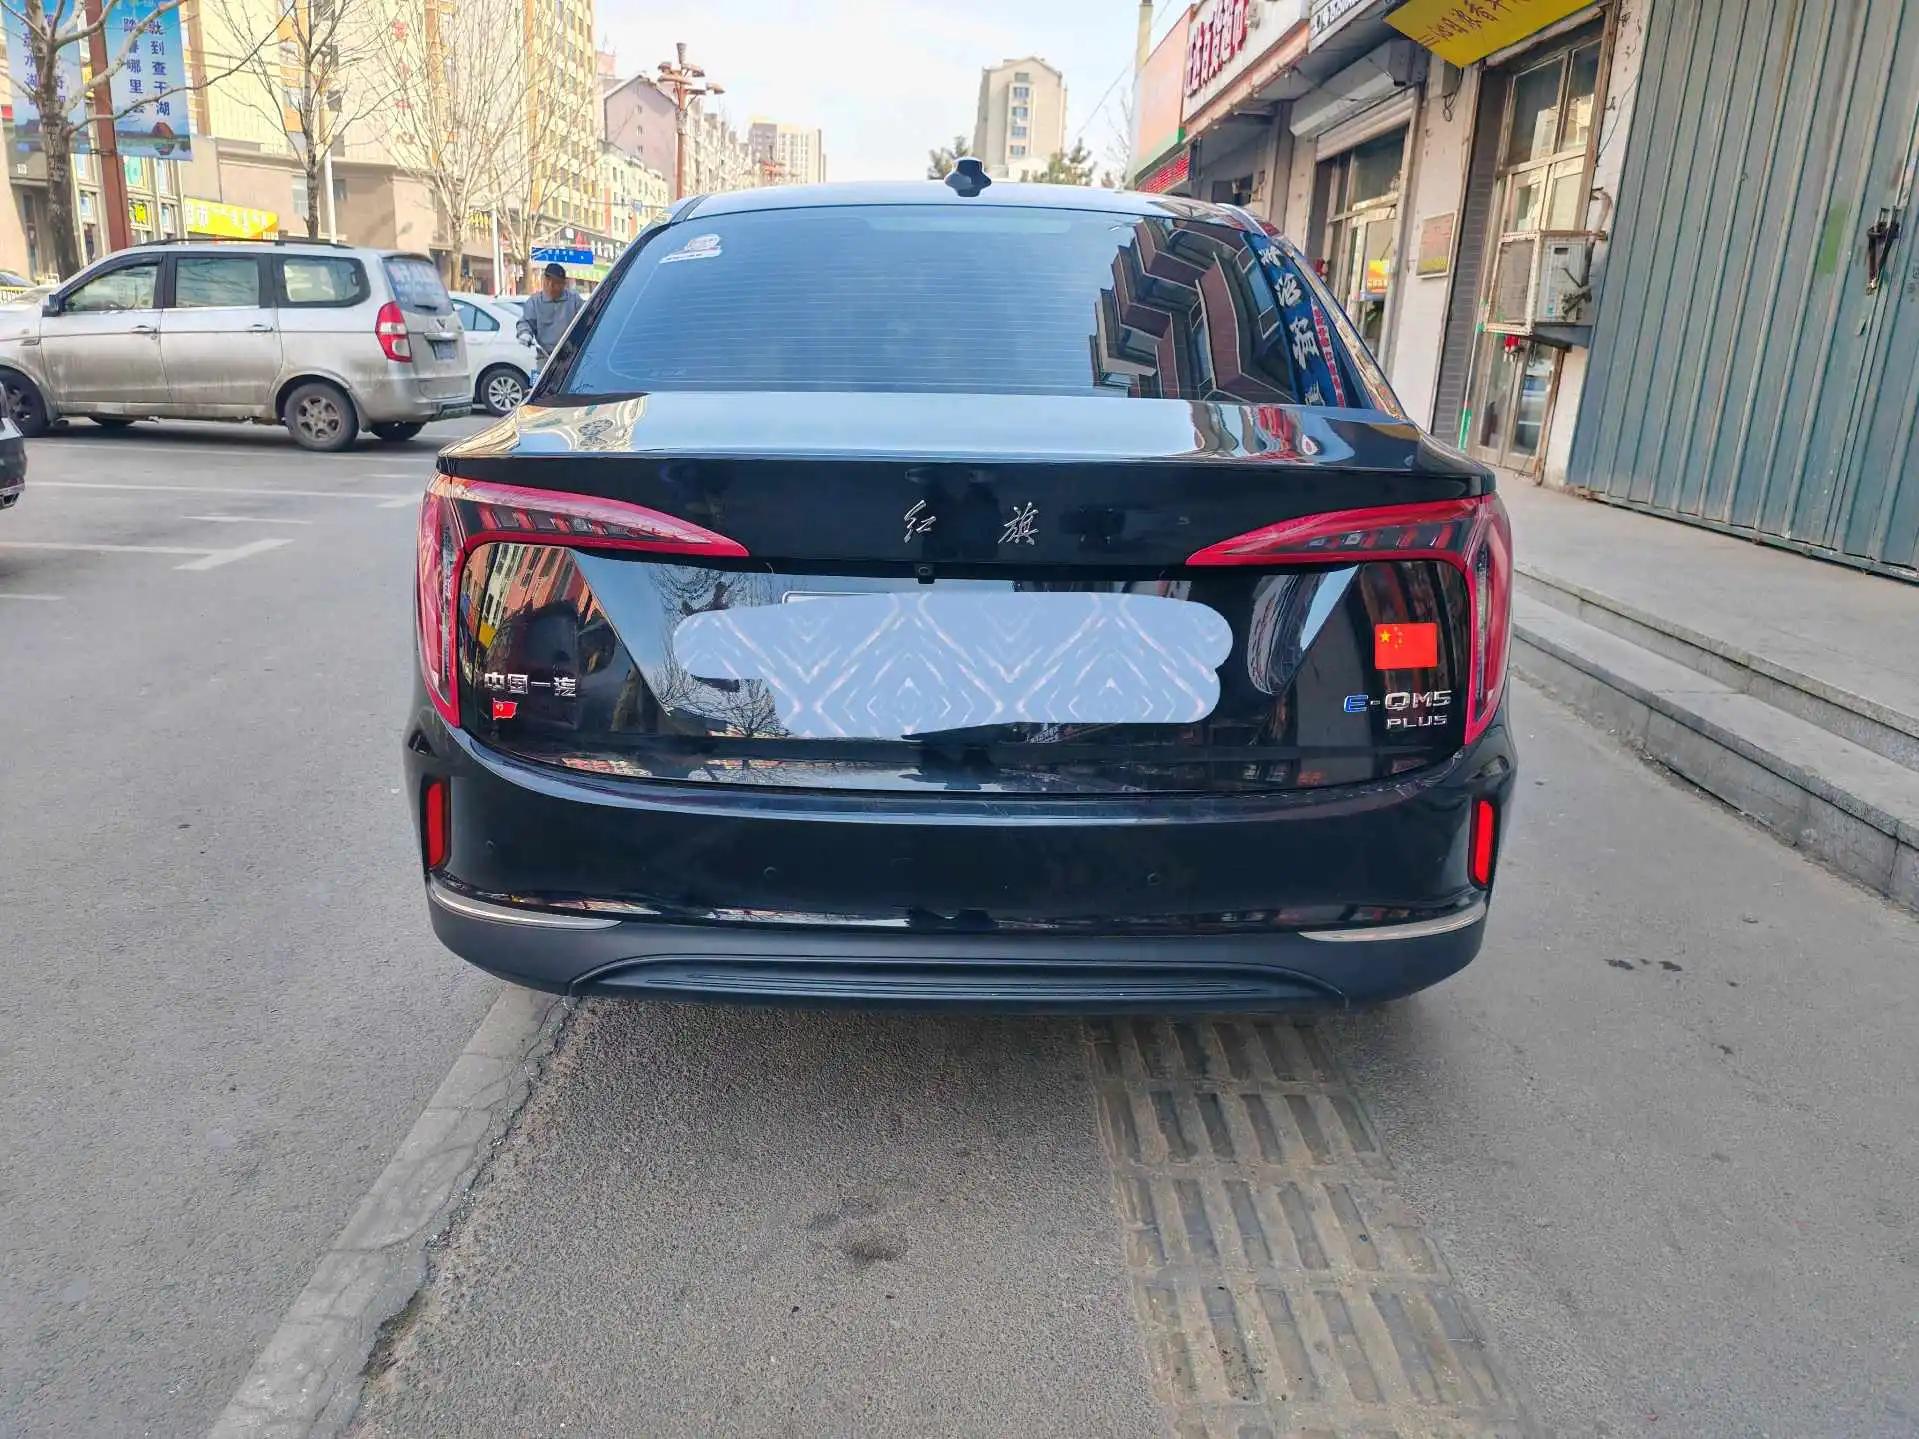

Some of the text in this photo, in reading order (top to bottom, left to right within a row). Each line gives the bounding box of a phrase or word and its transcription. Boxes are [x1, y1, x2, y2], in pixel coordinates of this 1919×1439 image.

[904, 500, 1039, 545] 红旗
[484, 672, 577, 698] 中国一汽
[1344, 690, 1452, 713] E-QM5
[1386, 715, 1448, 730] PLUS
